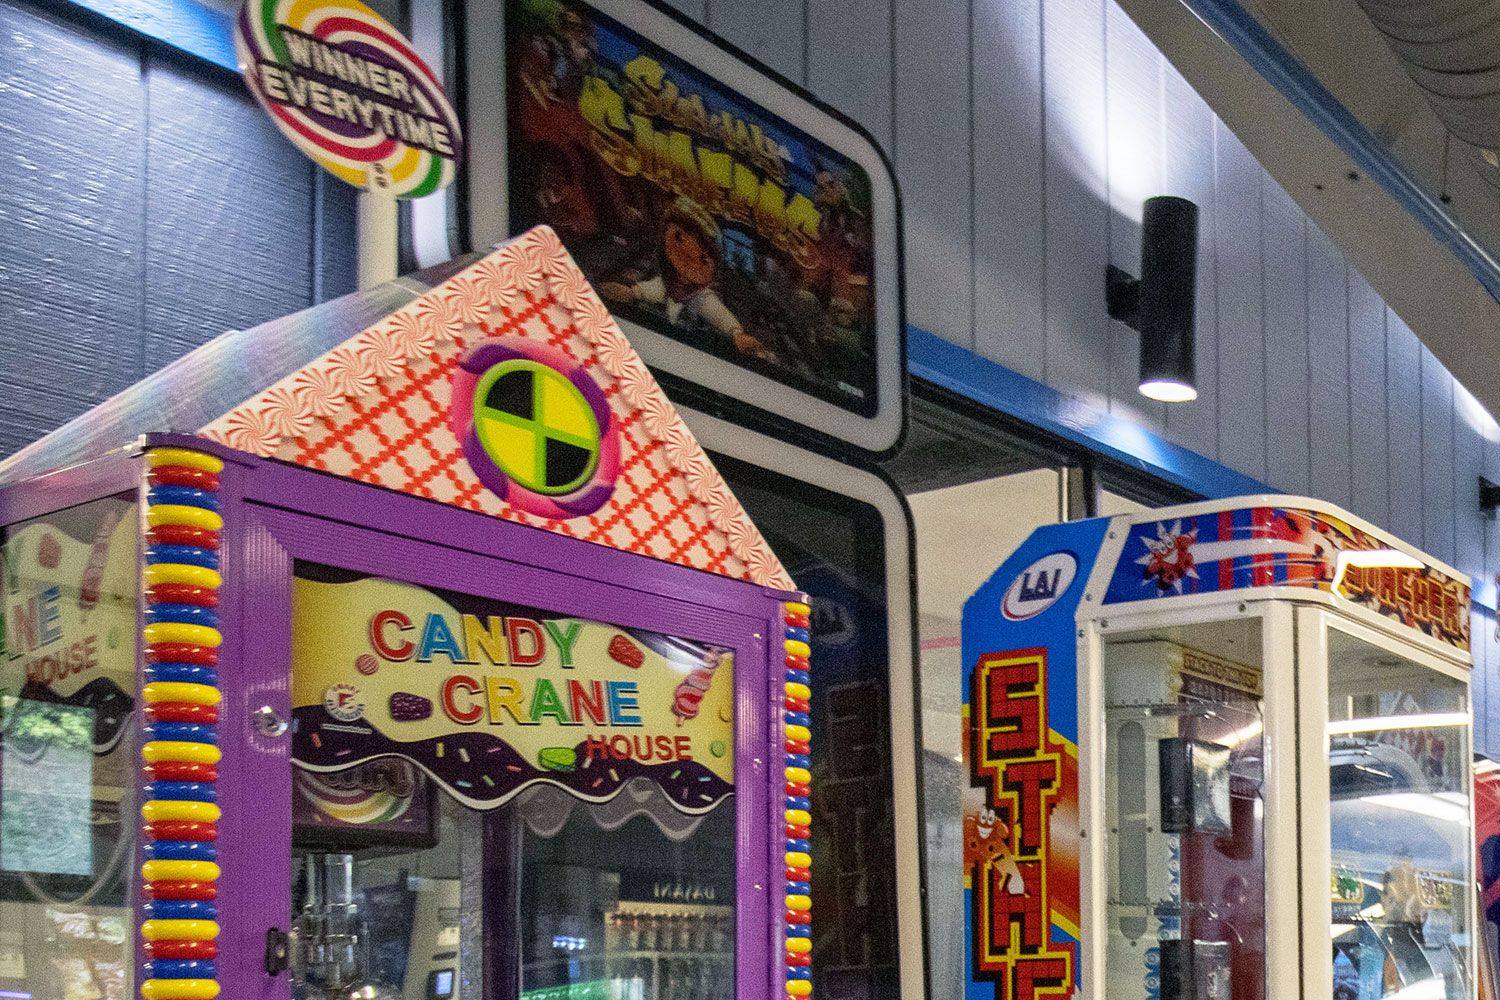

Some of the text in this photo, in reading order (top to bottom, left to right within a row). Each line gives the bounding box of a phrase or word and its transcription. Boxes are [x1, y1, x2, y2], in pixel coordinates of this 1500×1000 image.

[283, 29, 413, 105] WINNER
[261, 65, 455, 156] EVERYTIME
[580, 75, 822, 270] SURFERS
[1017, 568, 1062, 602] LAI
[370, 609, 583, 670] CANDY
[441, 675, 644, 726] CRANE
[586, 734, 692, 762] HOUSE
